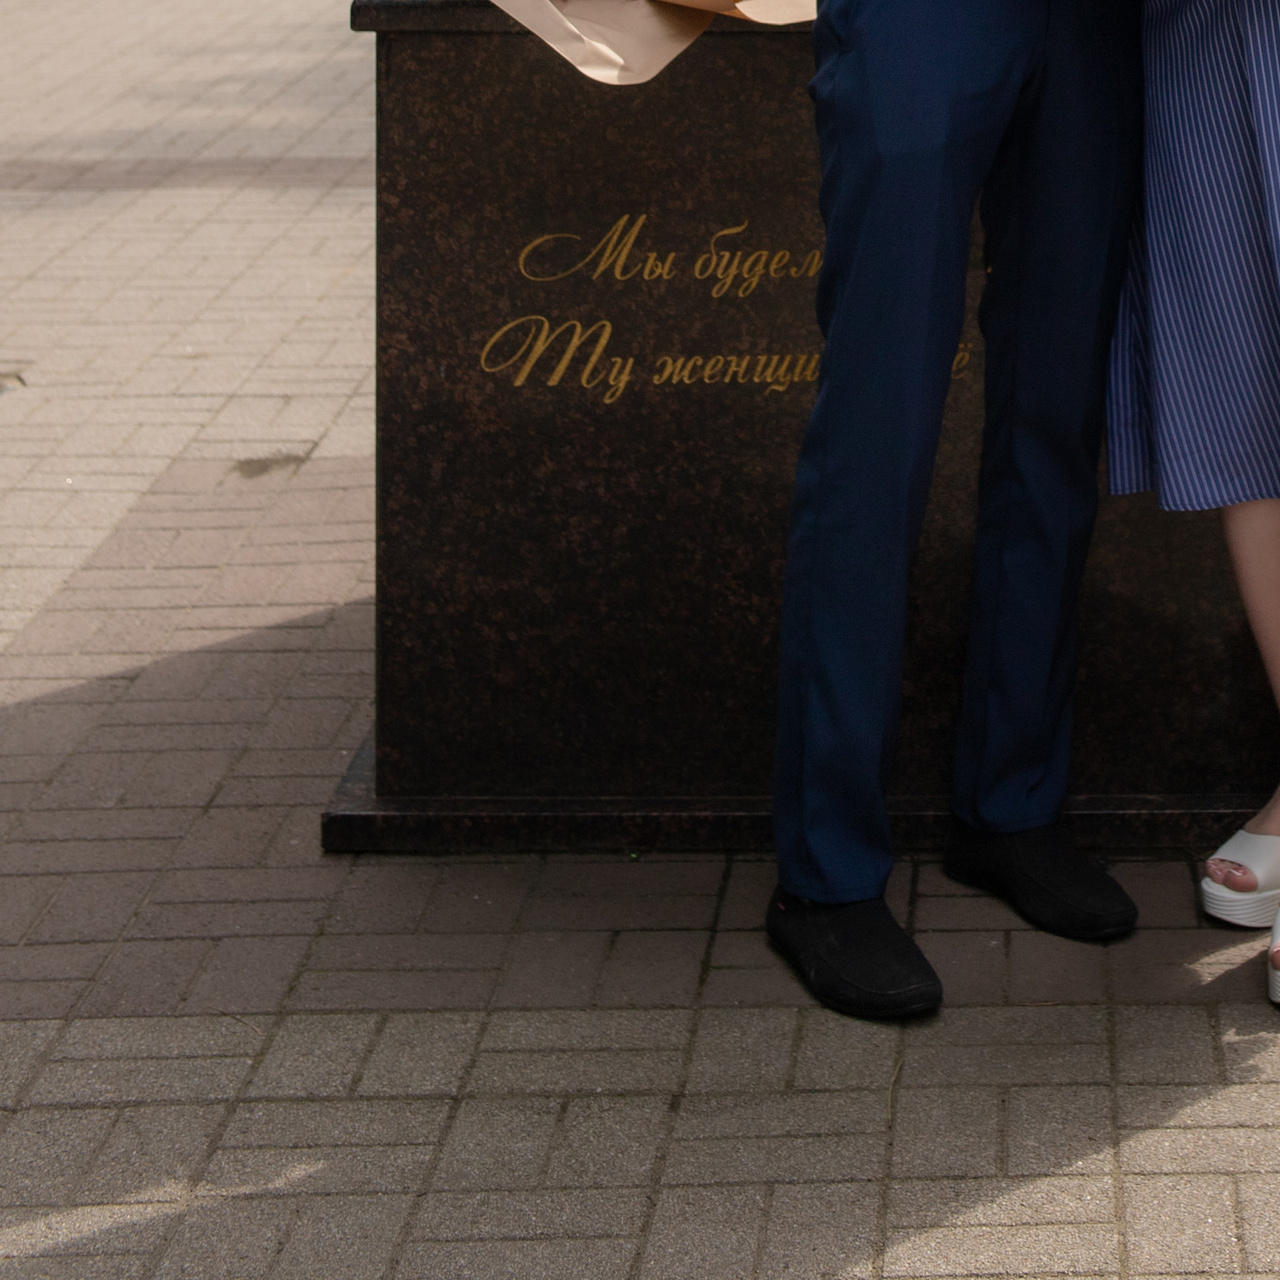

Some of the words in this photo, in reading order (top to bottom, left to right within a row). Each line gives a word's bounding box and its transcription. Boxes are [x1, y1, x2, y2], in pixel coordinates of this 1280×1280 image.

[518, 213, 675, 282] Мы
[480, 314, 634, 405] Ту
[652, 351, 821, 395] женщи
